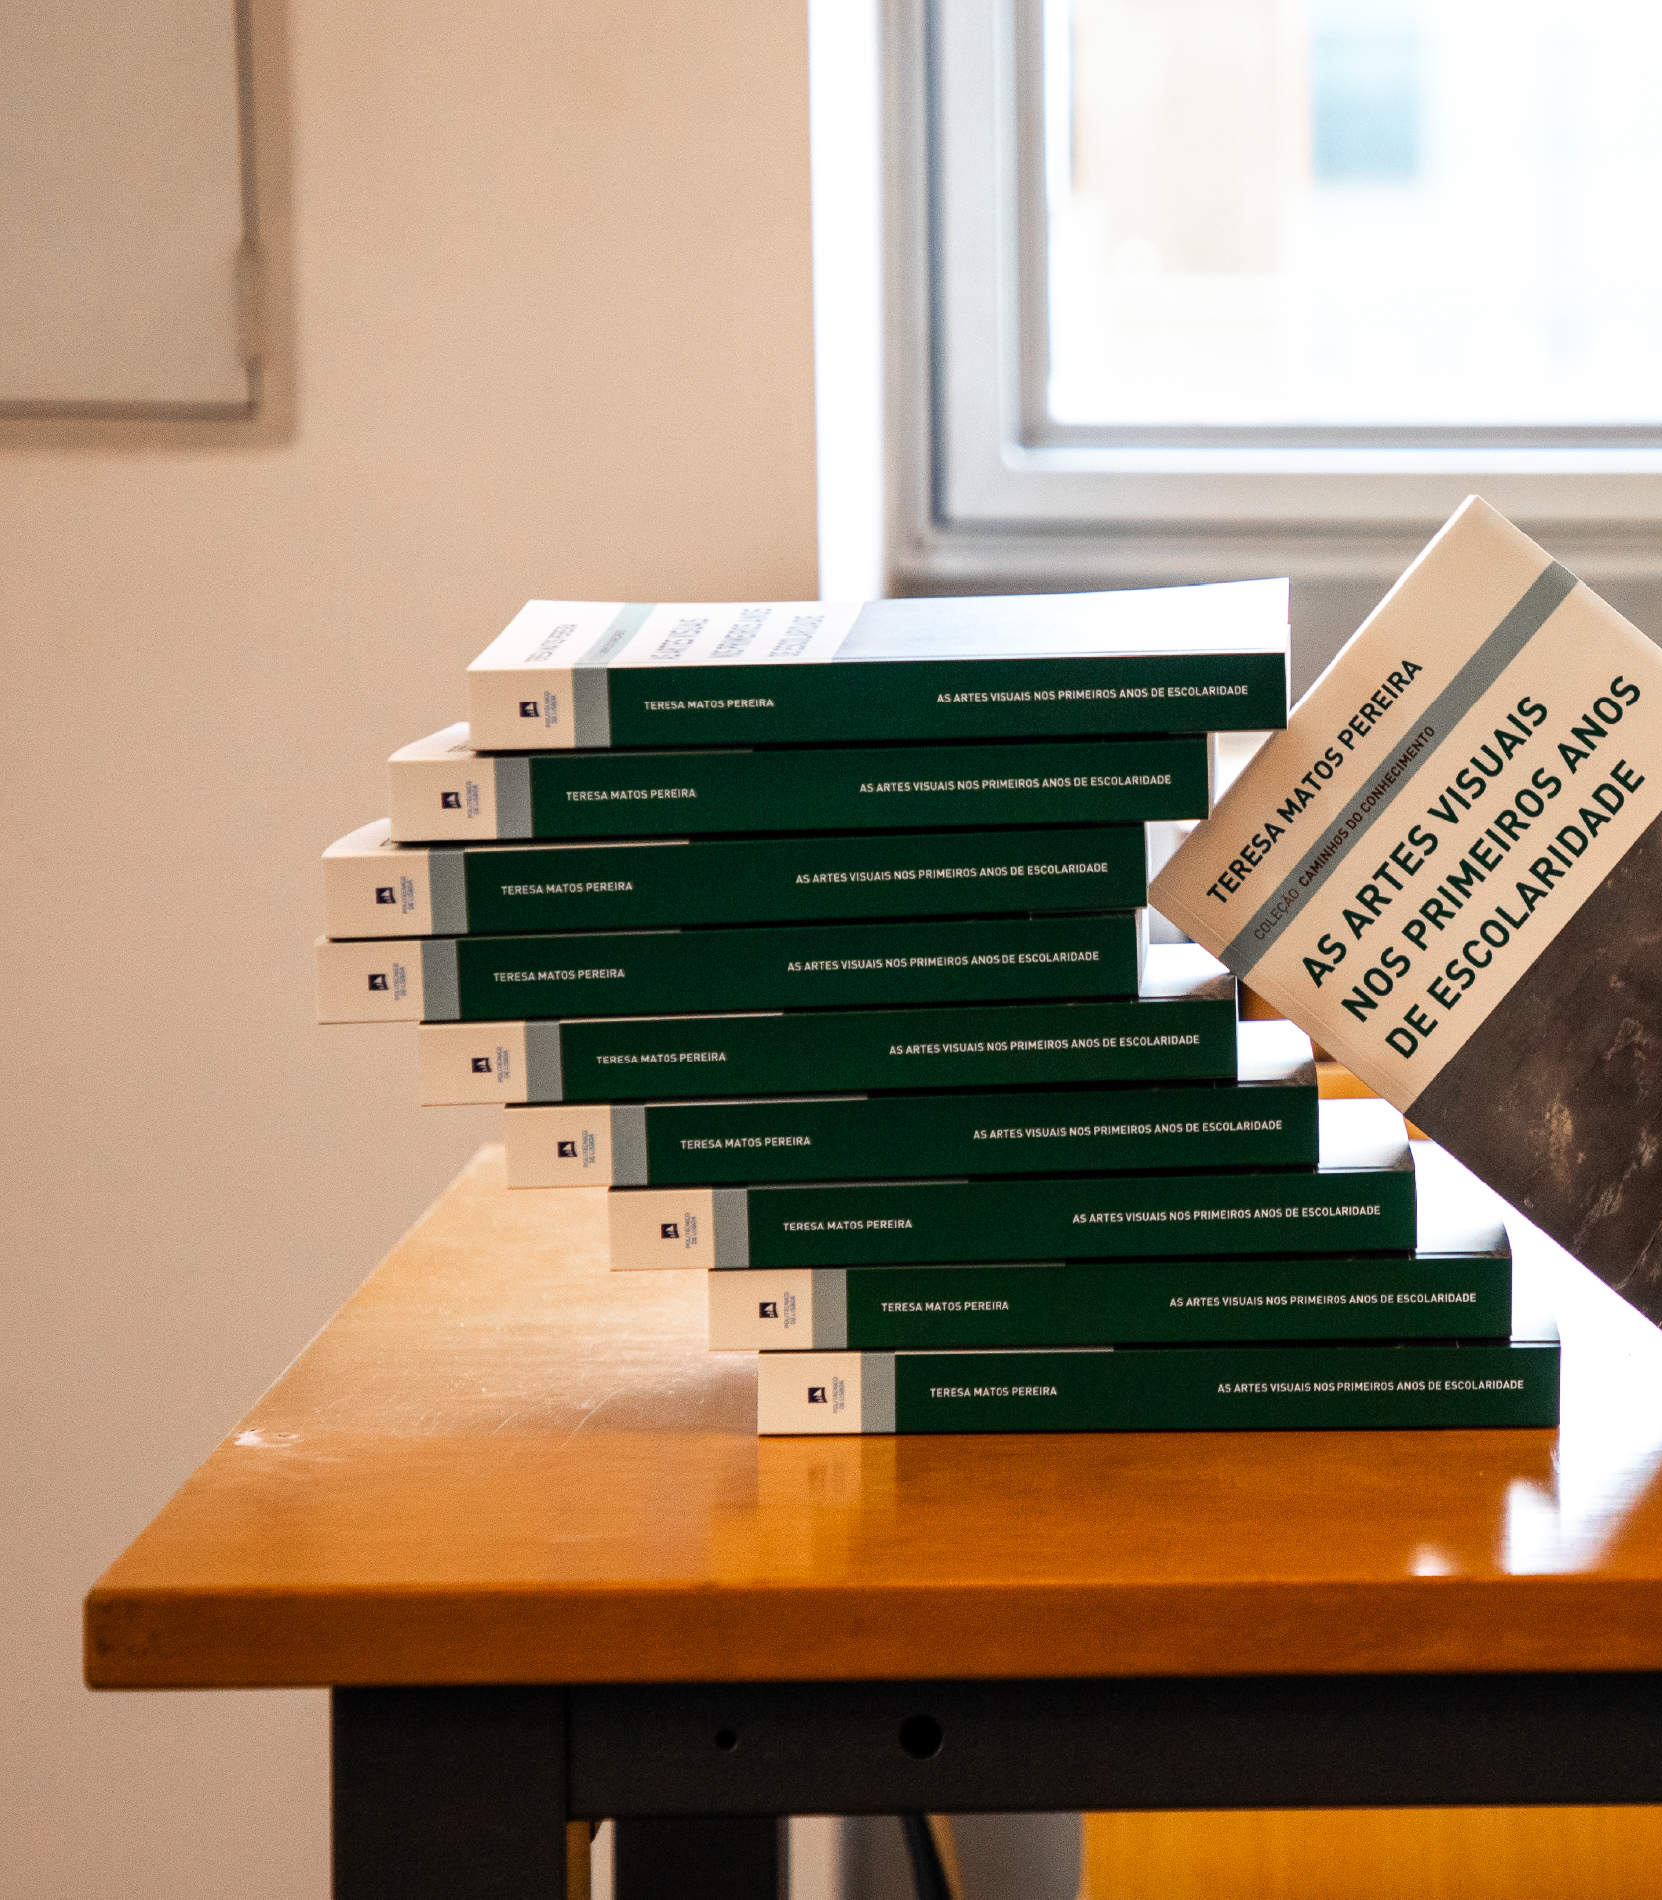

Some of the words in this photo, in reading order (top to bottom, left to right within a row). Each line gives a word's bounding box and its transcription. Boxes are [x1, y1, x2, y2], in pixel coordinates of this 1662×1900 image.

[644, 700, 686, 711] TERESA
[686, 699, 726, 709] MATOS
[725, 698, 775, 709] PEREIRA
[859, 782, 875, 794] AS
[875, 781, 912, 793] ARTES
[912, 780, 956, 792] VISUAIS
[956, 779, 981, 791] NOS
[981, 777, 1041, 790] PRIMEIROS
[1041, 776, 1072, 788] ANOS
[1072, 776, 1088, 788] DE
[1089, 773, 1172, 787] ESCOLARIDADE
[1207, 823, 1285, 903] TERESA
[1277, 748, 1343, 823] MATOS
[1338, 661, 1422, 750] PEREIRA
[565, 790, 610, 802] TERESA
[609, 789, 649, 800] MATOS
[649, 787, 697, 800] PEREIRA
[1253, 888, 1299, 941] COLEÇÃO
[1298, 829, 1350, 887] CAMINHOS
[1345, 811, 1363, 831] DO
[1360, 726, 1435, 814] CONHECIMENTO
[1303, 934, 1346, 988] AS
[1343, 825, 1438, 939] ARTES
[1428, 697, 1547, 823] VISUAIS
[1341, 947, 1410, 1022] NOS
[1402, 768, 1561, 950] PRIMEIROS
[1558, 676, 1640, 773] ANOS
[795, 873, 812, 884] AS
[811, 872, 849, 884] ARTES
[848, 870, 893, 883] VISUAIS
[893, 869, 917, 881] NOS
[917, 867, 978, 880] PRIMEIROS
[978, 865, 1009, 878] ANOS
[1009, 865, 1025, 877] DE
[1026, 861, 1109, 876] ESCOLARIDADE
[500, 884, 545, 896] TERESA
[545, 882, 585, 894] MATOS
[585, 880, 634, 893] PEREIRA
[1385, 1004, 1438, 1058] DE
[1427, 760, 1644, 1009] ESCOLARIDADE
[493, 971, 537, 983] TERESA
[537, 969, 577, 981] MATOS
[576, 967, 626, 980] PEREIRA
[888, 1044, 904, 1056] AS
[904, 1043, 942, 1055] ARTES
[941, 1041, 985, 1053] VISUAIS
[985, 1040, 1009, 1052] NOS
[1009, 1038, 1070, 1051] PRIMEIROS
[1070, 1037, 1101, 1049] ANOS
[1101, 1037, 1117, 1048] DE
[1118, 1034, 1200, 1048] ESCOLARIDADE
[595, 1054, 639, 1065] TERESA
[639, 1052, 679, 1063] MATOS
[678, 1051, 727, 1063] PEREIRA
[680, 1138, 724, 1150] TERESA
[724, 1136, 763, 1149] MATOS
[763, 1135, 812, 1147] PEREIRA
[1072, 1213, 1088, 1224] AS
[1088, 1212, 1124, 1223] ARTES
[1125, 1211, 1168, 1222] VISUAIS
[1168, 1210, 1192, 1221] NOS
[1192, 1208, 1252, 1221] PRIMEIROS
[1253, 1207, 1283, 1219] ANOS
[1284, 1206, 1300, 1219] DE
[1301, 1204, 1381, 1218] ESCOLARIDADE
[782, 1221, 825, 1232] TERESA
[826, 1219, 865, 1230] MATOS
[865, 1218, 914, 1230] PEREIRA
[880, 1301, 924, 1313] TERESA
[924, 1300, 963, 1312] MATOS
[963, 1300, 1010, 1312] PEREIRA
[929, 1386, 972, 1398] TERESA
[972, 1386, 1010, 1397] MATOS
[1011, 1385, 1058, 1397] PEREIRA
[1217, 1382, 1232, 1394] AS
[1233, 1382, 1269, 1394] ARTES
[1269, 1382, 1312, 1393] VISUAIS
[1312, 1381, 1336, 1392] NOS
[1336, 1380, 1395, 1392] PRIMEIROS
[1395, 1380, 1426, 1391] ANOS
[1427, 1380, 1442, 1391] DE
[1443, 1378, 1525, 1391] ESCOLARIDADE
